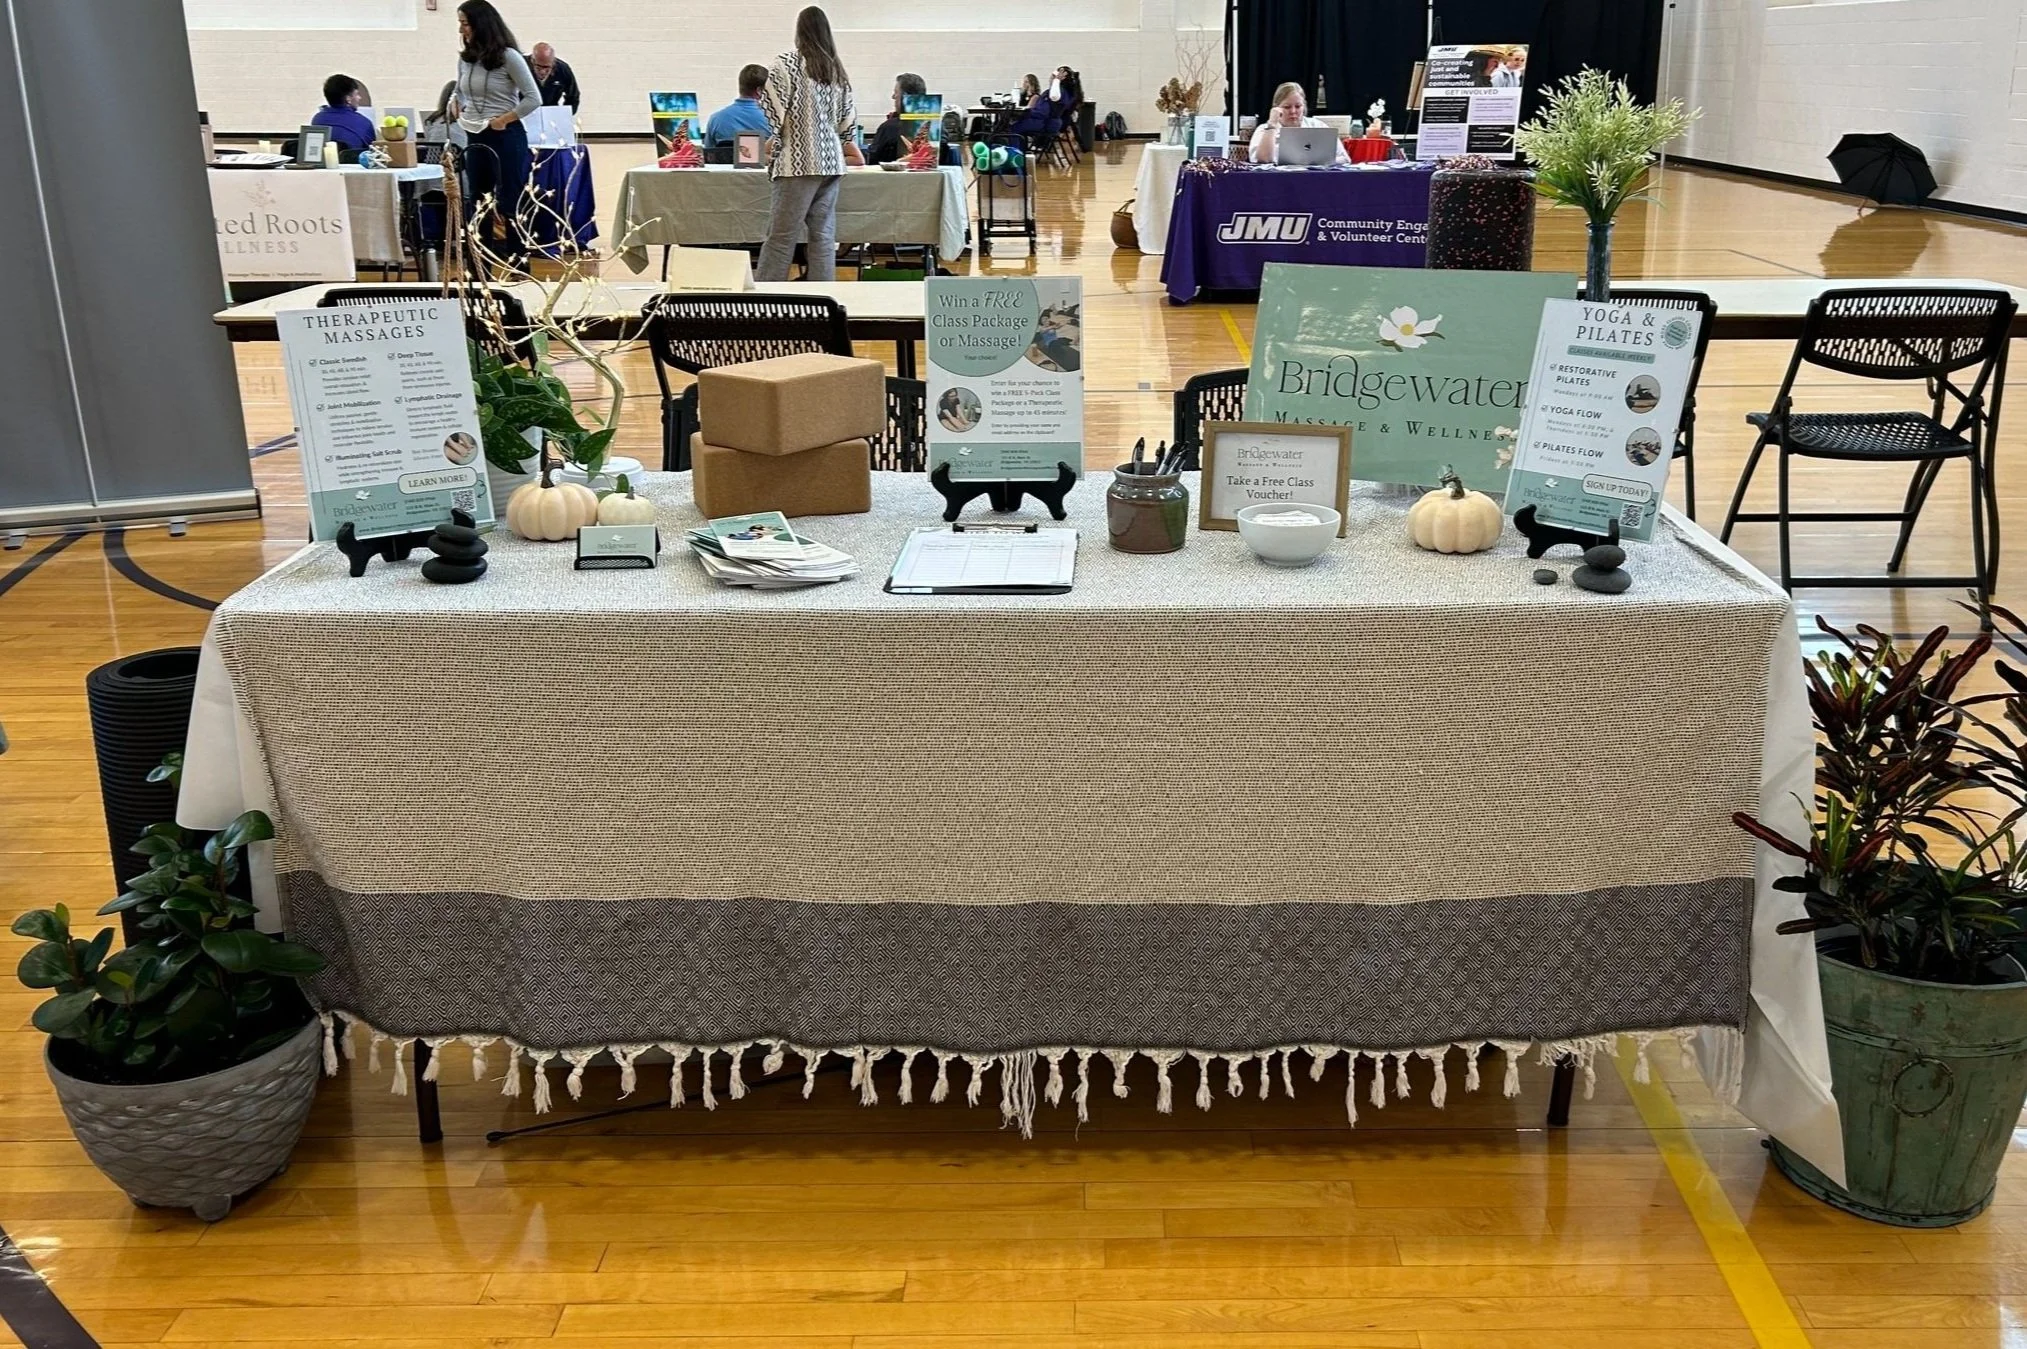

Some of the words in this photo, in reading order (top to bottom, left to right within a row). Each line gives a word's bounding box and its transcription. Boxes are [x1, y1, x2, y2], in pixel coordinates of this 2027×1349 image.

[265, 213, 343, 235] Roots
[1219, 213, 1311, 243] JMU
[1317, 218, 1393, 232] Community
[1317, 232, 1327, 242] &
[1330, 232, 1394, 242] Volunteer
[939, 294, 968, 308] Win
[971, 299, 980, 308] a
[983, 290, 1024, 308] FREE
[303, 308, 440, 328] THERAPEUTIC
[932, 314, 968, 328] Class
[971, 314, 1028, 330] Package
[1583, 307, 1632, 325] YOGA
[1642, 312, 1656, 327] &
[324, 325, 425, 344] MASSAGES
[940, 336, 955, 347] or
[958, 334, 1022, 350] Massage!
[1576, 326, 1654, 346] PILATES
[1558, 364, 1616, 378] RESTORATIVE
[1278, 354, 1528, 410] Bridgewater
[1556, 376, 1590, 386] PILATES
[1550, 406, 1574, 416] YOGA
[1576, 409, 1602, 420] FLOW
[1380, 424, 1391, 434] &
[1237, 446, 1304, 461] Bridgewater
[1542, 442, 1576, 454] PILATES
[1578, 448, 1604, 458] FLOW
[408, 476, 438, 488] LEARN
[440, 474, 468, 484] MORE!
[1226, 476, 1251, 486] Take
[1253, 478, 1260, 486] a
[1262, 476, 1284, 486] Free
[1287, 476, 1314, 488] Class
[1586, 480, 1604, 490] SIGN
[1606, 482, 1617, 492] UP
[1618, 485, 1649, 497] TODAY!
[1246, 490, 1294, 500] Voucher!
